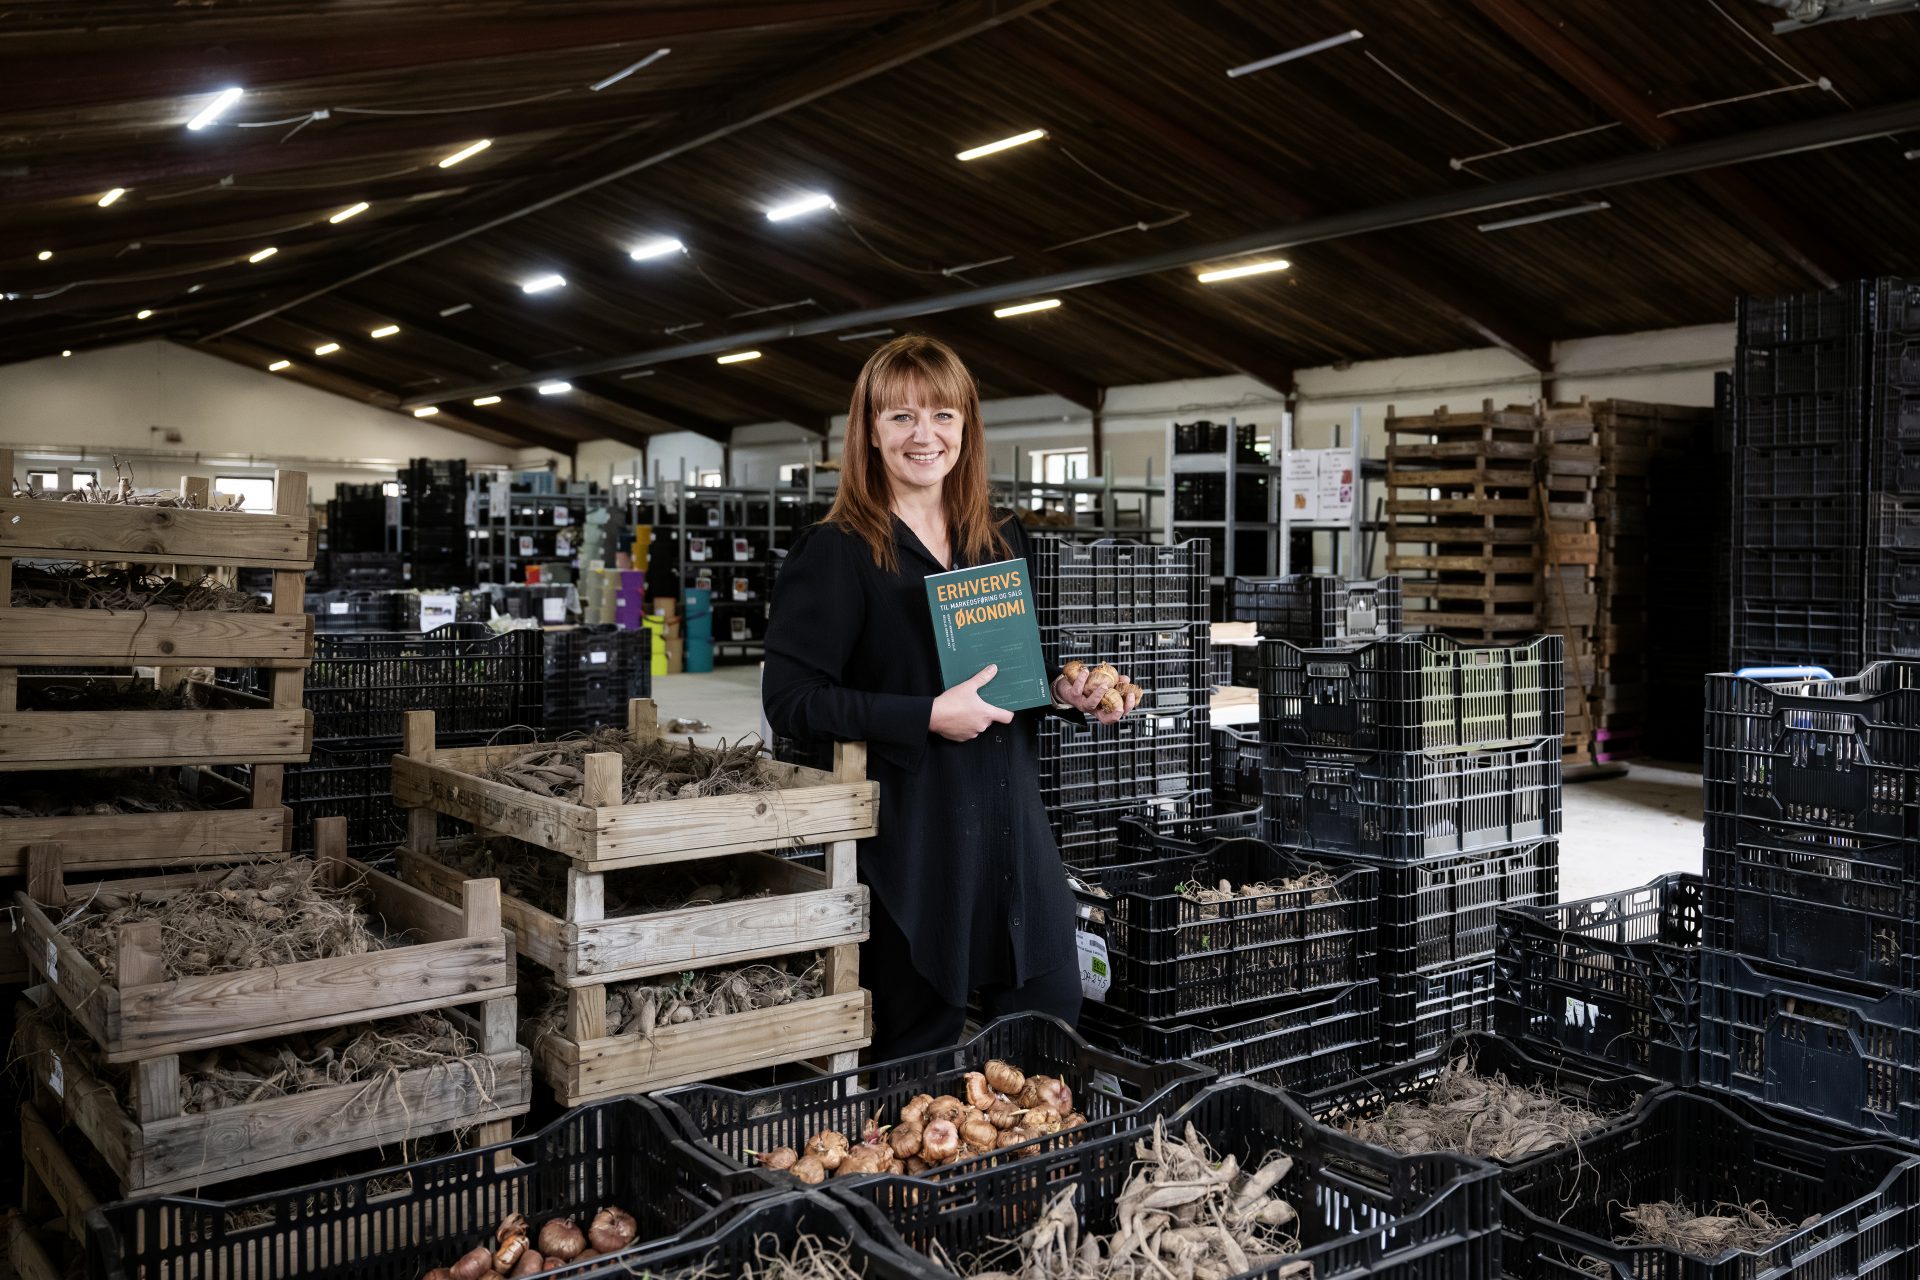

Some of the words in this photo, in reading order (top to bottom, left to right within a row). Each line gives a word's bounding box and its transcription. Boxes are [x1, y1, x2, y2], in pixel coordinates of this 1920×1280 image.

[937, 571, 1022, 602] ERHVERVS
[940, 603, 949, 611] TIL
[999, 592, 1007, 600] OG
[1008, 589, 1023, 598] SALG
[955, 599, 1026, 630] ØKONOMI
